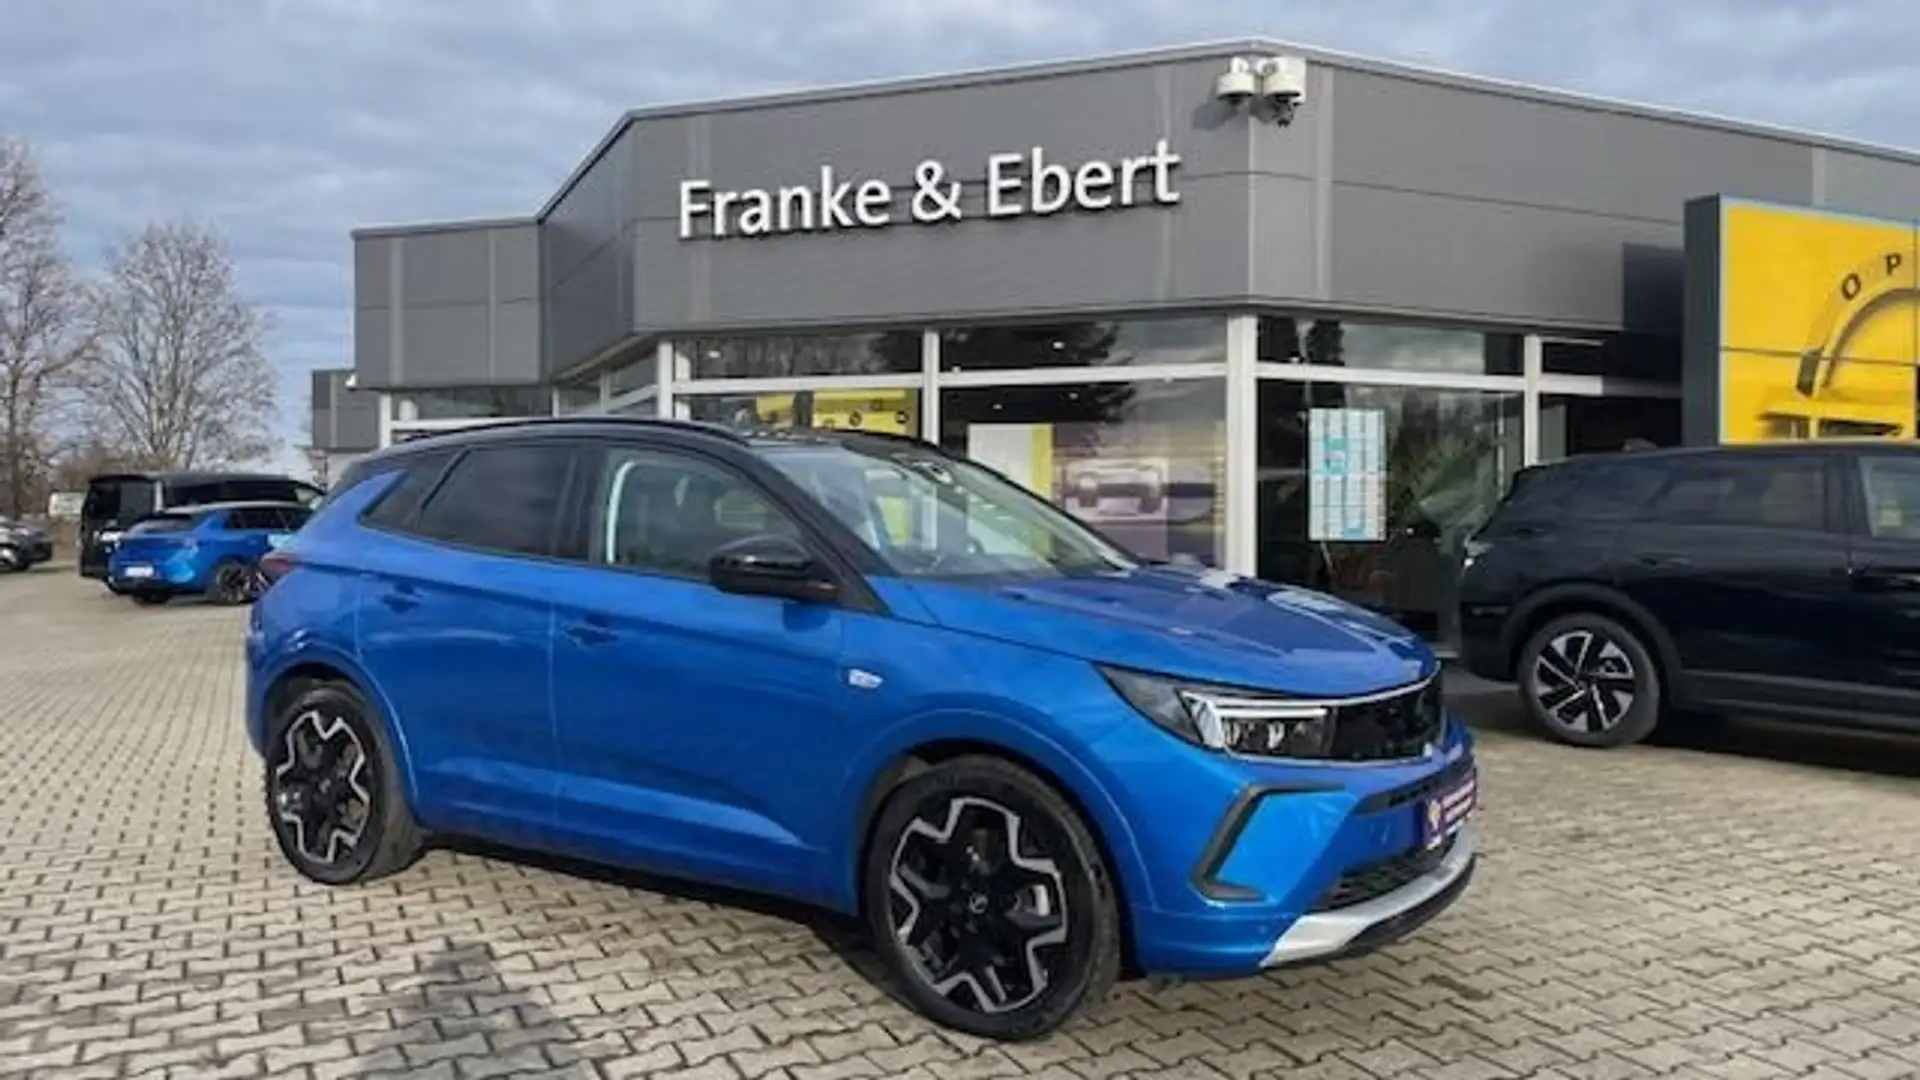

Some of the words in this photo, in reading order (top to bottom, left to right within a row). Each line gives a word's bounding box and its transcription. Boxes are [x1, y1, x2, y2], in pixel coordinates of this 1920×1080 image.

[679, 165, 891, 238] Franke
[911, 160, 962, 222] &
[986, 139, 1182, 216] Ebert
